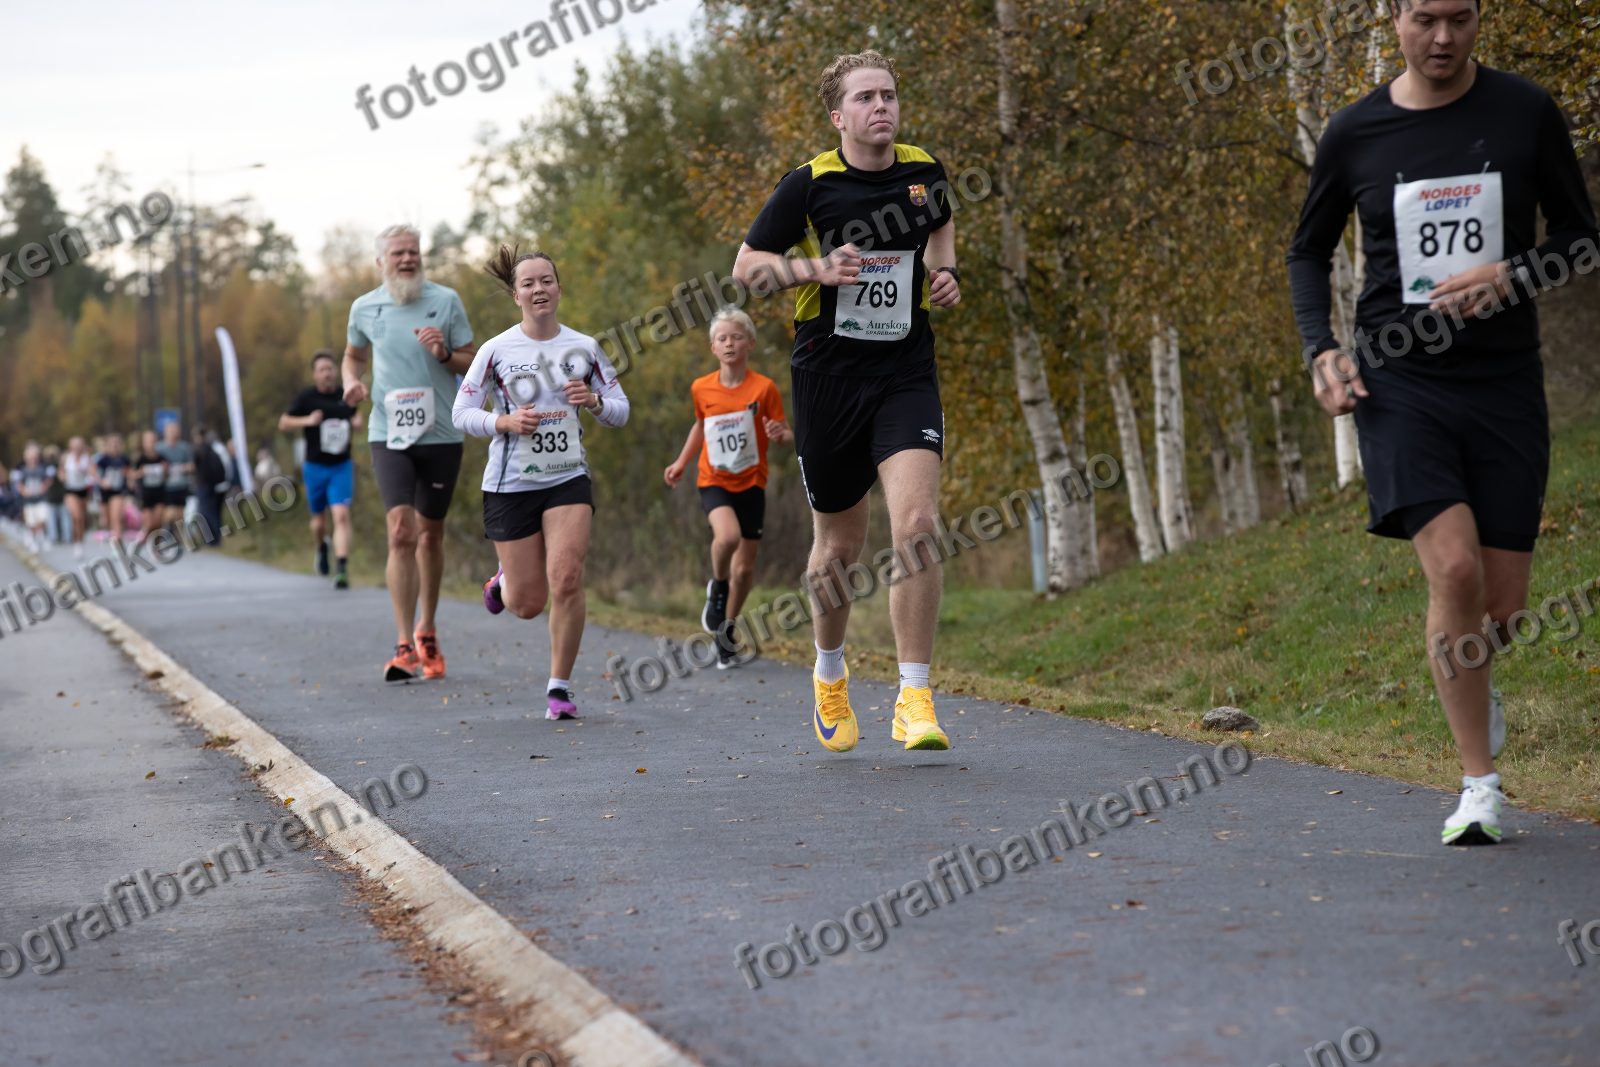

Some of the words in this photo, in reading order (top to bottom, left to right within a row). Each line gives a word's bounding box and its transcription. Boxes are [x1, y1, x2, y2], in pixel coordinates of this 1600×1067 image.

[1419, 184, 1482, 200] NORGES
[1425, 197, 1472, 211] LØPET
[1420, 218, 1484, 257] 878
[861, 256, 901, 265] NORGES
[861, 265, 893, 273] LØPET
[855, 280, 898, 308] 769
[866, 320, 909, 332] Aurskog
[395, 408, 425, 427] 299
[541, 410, 568, 419] ORGES
[532, 431, 568, 454] 333
[717, 432, 747, 453] 105
